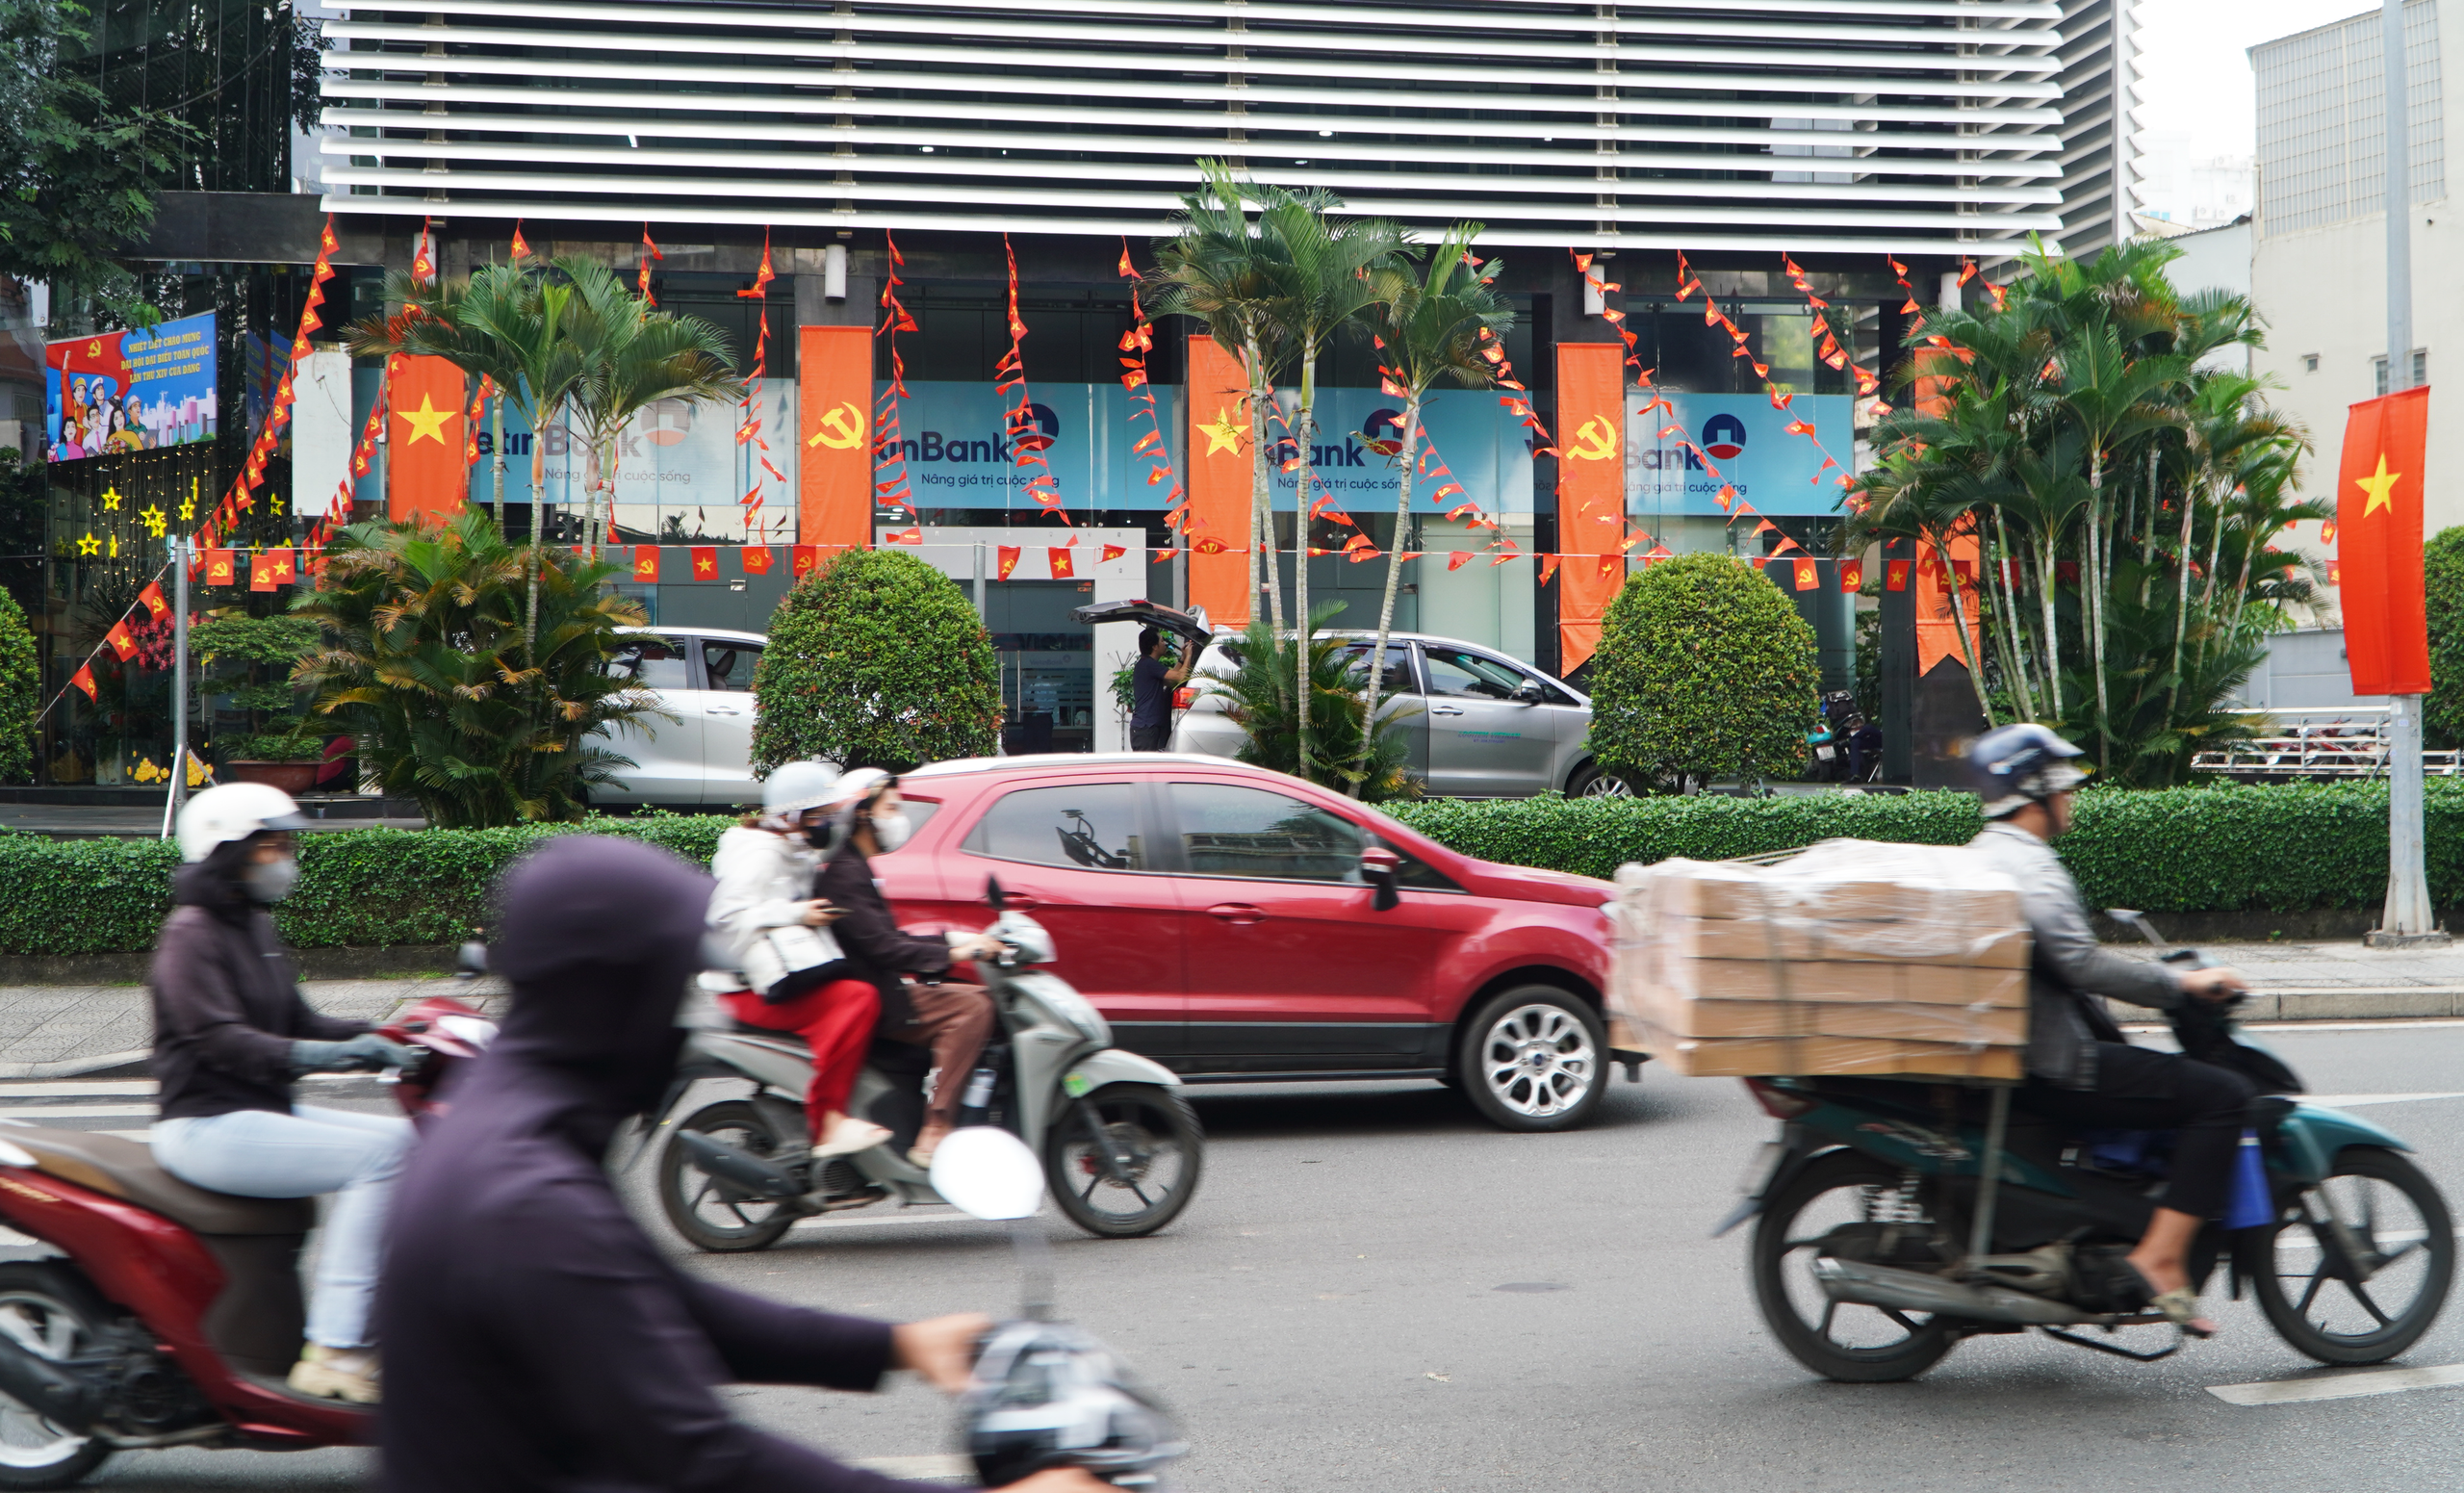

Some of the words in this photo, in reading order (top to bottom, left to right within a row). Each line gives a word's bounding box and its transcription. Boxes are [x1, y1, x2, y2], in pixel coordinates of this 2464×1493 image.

[156, 368, 168, 379] XIV
[545, 468, 580, 482] Nâng
[624, 469, 656, 484] cuộc
[659, 466, 691, 484] sống
[921, 474, 955, 488] Nâng
[958, 474, 979, 488] giá
[981, 475, 994, 488] trị
[996, 475, 1027, 488] cuộc
[1313, 477, 1332, 491] giá
[1335, 477, 1348, 490] trị
[1349, 477, 1379, 490] cuộc
[1381, 476, 1402, 489] sốn
[1629, 482, 1650, 495] âng
[1654, 482, 1672, 495] giá
[1675, 481, 1686, 495] trị
[1689, 481, 1717, 495] cuộc
